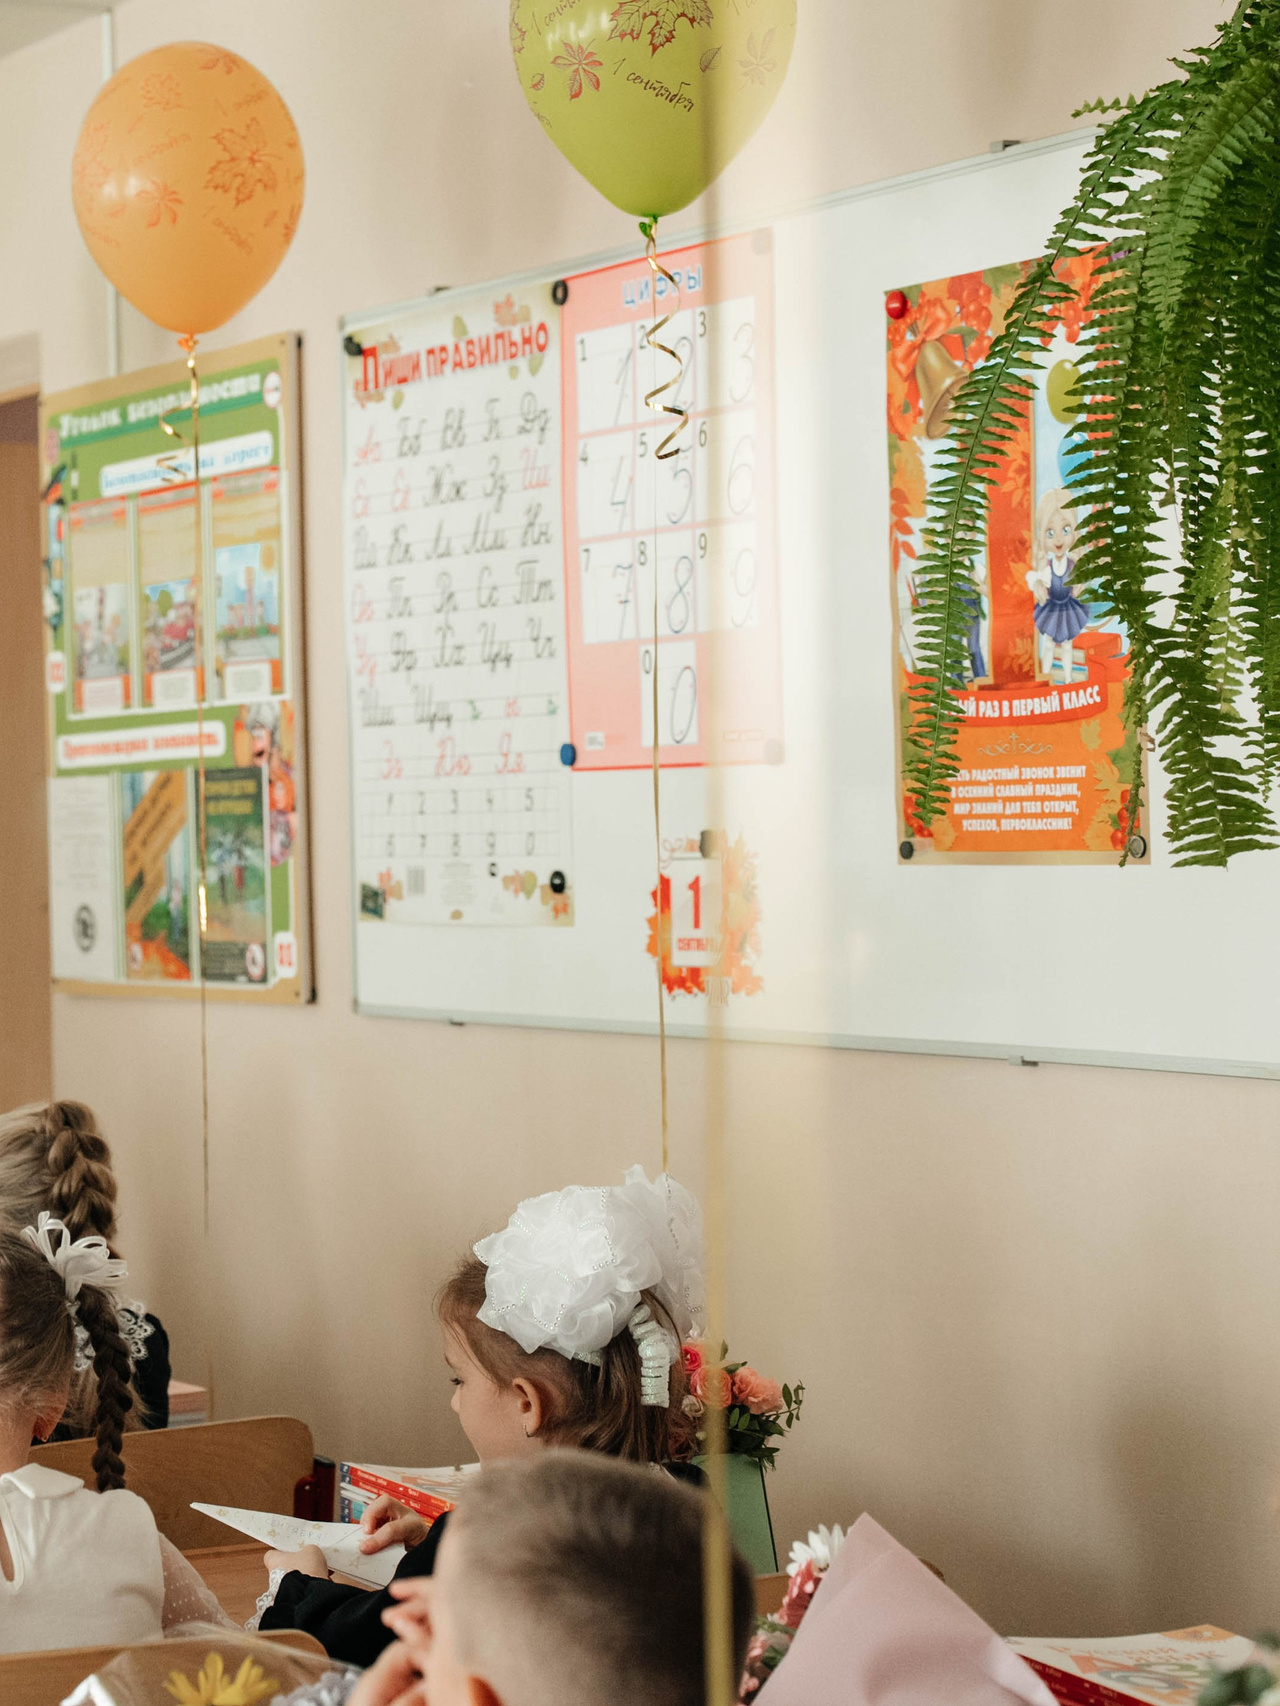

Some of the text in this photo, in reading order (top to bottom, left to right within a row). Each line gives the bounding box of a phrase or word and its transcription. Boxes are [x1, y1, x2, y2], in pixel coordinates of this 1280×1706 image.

[626, 71, 694, 112] сентября
[622, 263, 703, 310] ЦИФРЫ
[579, 337, 588, 362] 1
[638, 325, 648, 350] 2
[698, 310, 707, 338] 3
[638, 432, 649, 458] 5
[698, 421, 708, 448] 6
[583, 547, 590, 573] 7
[638, 540, 648, 566] 8
[698, 532, 708, 559] 9
[642, 649, 652, 675] 0
[979, 700, 1000, 718] РАЗ
[1002, 700, 1010, 717] В
[1012, 691, 1060, 717] ПЕРВЫЙ
[1062, 684, 1101, 710] КЛАСС
[958, 783, 994, 798] ОСЕННИЙ
[995, 782, 1033, 797] СЛАВНЫЙ
[1035, 783, 1081, 798] ПРАЗДНИК,
[972, 765, 1020, 782] РАДОСТНЫЙ
[1021, 766, 1055, 779] ЗВОНОК
[1056, 765, 1086, 779] ЗВЕНИТ
[953, 799, 1079, 815] МИР ЗНАНИЙ ДЛЯ ТЕБЯ ОТКРЫТ,
[962, 817, 1072, 833] УСПЕХОВ, ПЕРВОКЛАССНИК!
[688, 875, 701, 929] 1
